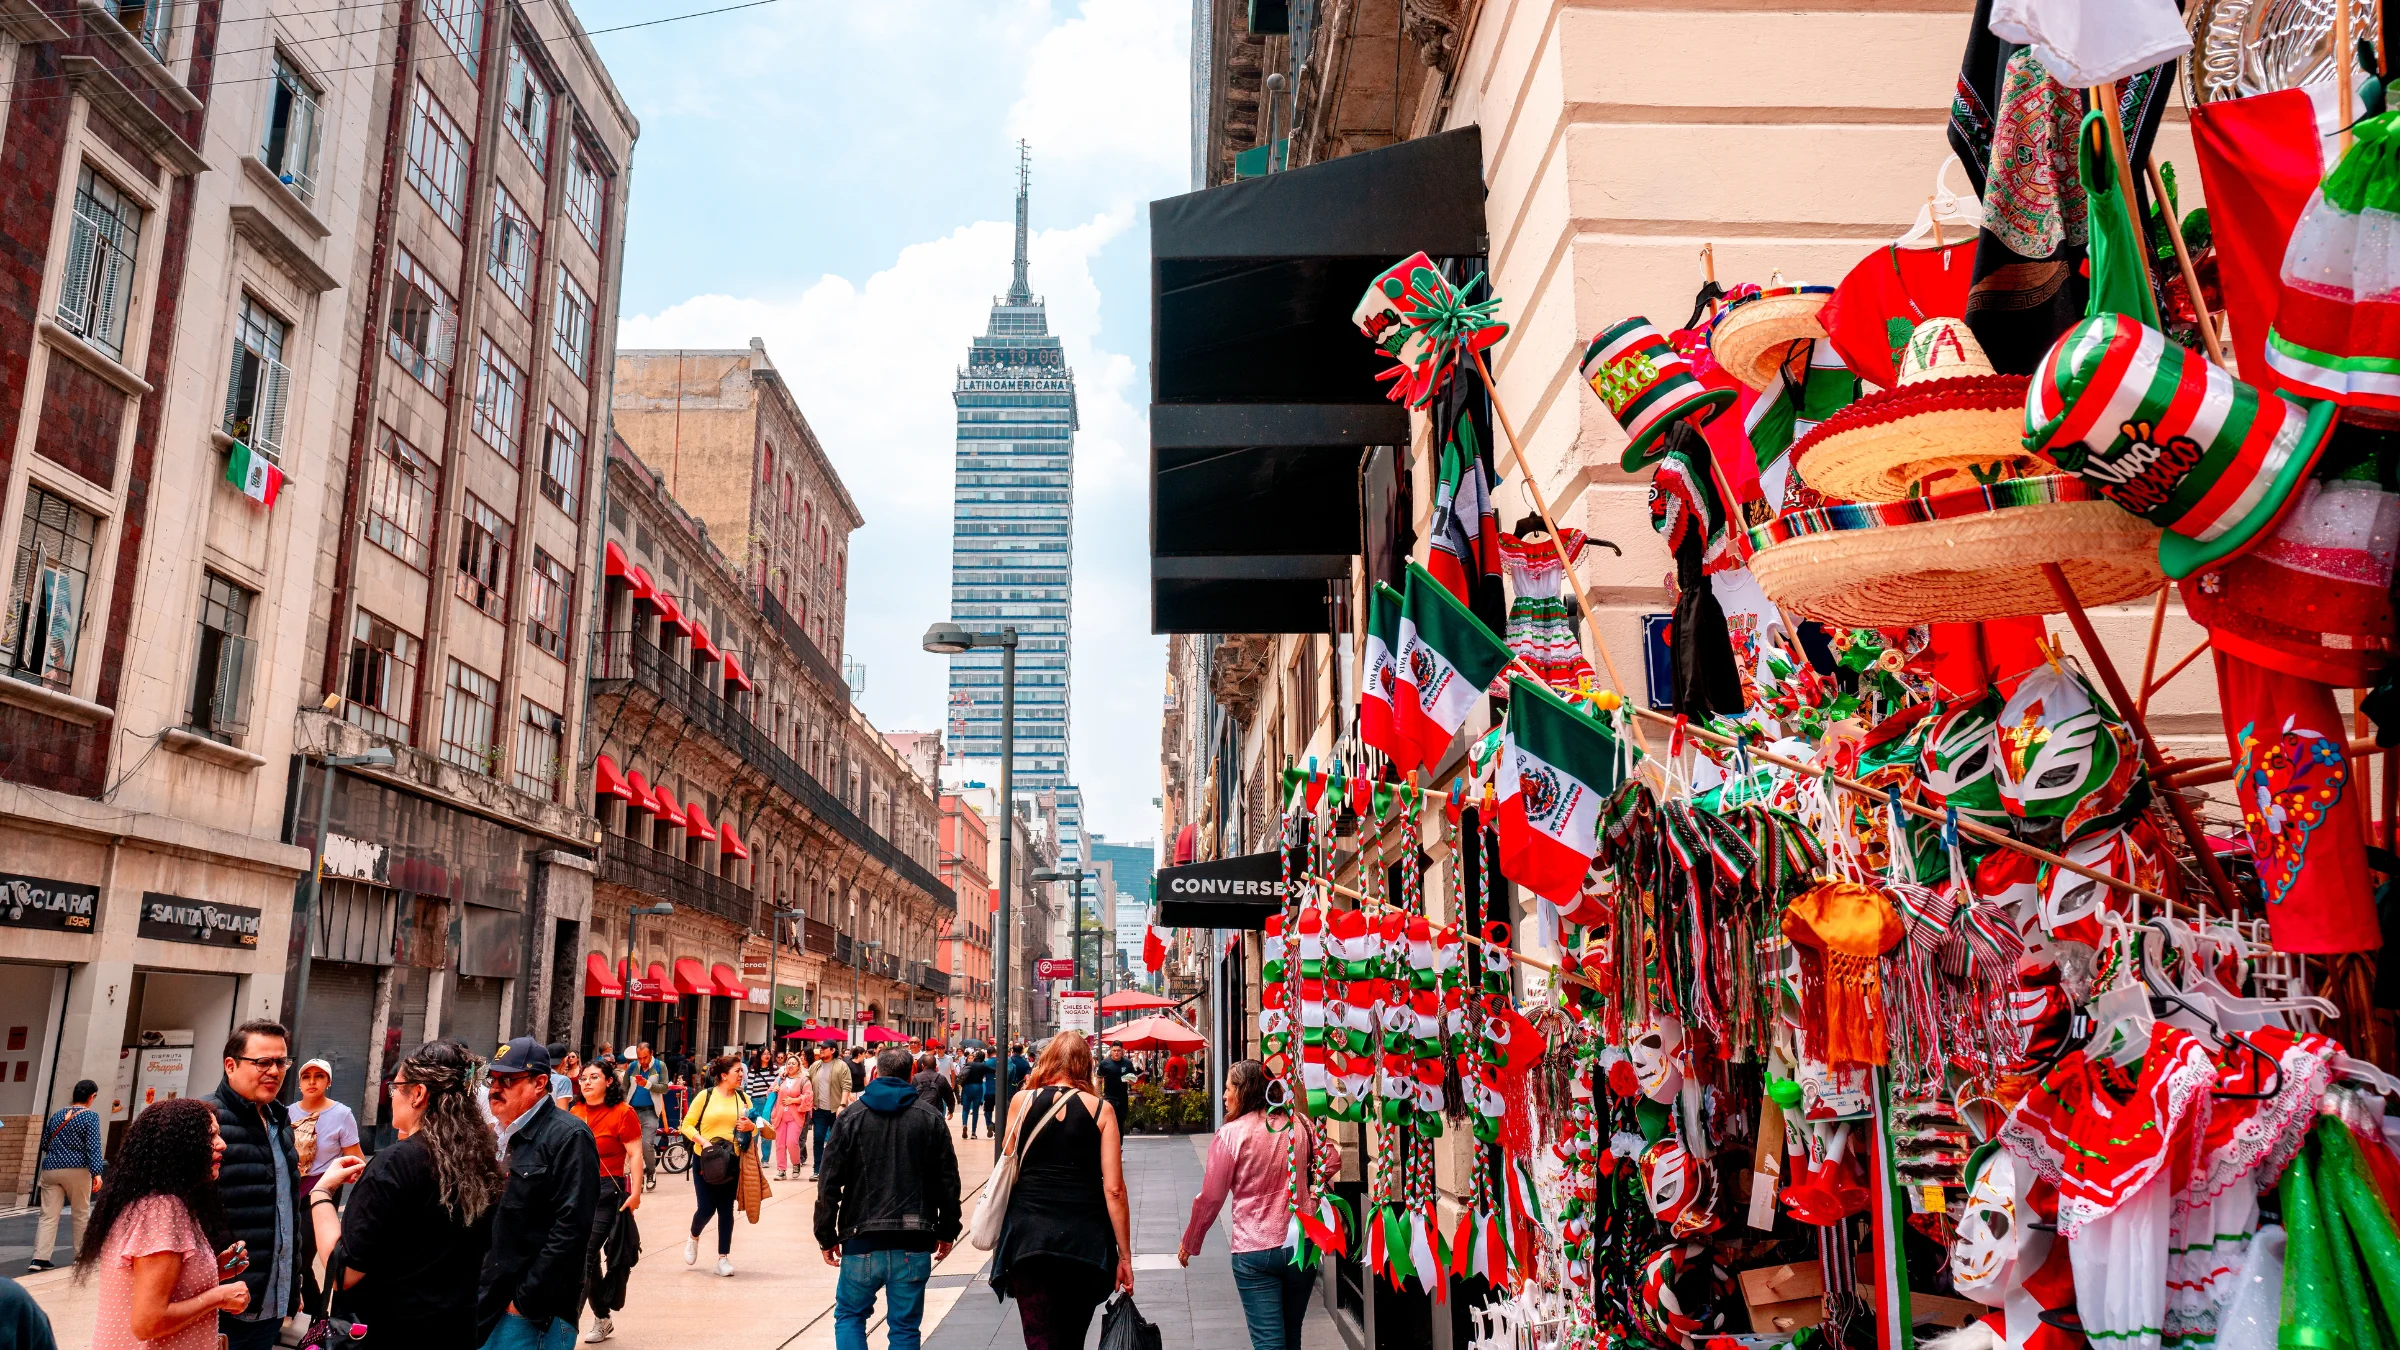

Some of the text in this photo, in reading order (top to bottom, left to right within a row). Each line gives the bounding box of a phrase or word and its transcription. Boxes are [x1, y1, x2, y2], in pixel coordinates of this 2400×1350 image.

[977, 349, 1059, 365] 13:19:06
[963, 380, 1064, 390] LATINOAMERICANA
[1601, 359, 1637, 393] VIVA
[1608, 367, 1656, 411] MEXICO
[2083, 441, 2161, 484] Viva
[1369, 648, 1388, 690] VIVA MEXIC
[1398, 656, 1408, 674] VIVA
[1549, 783, 1583, 837] MEXICO
[1171, 877, 1283, 896] CONVERSE
[29, 888, 94, 915] CLARA
[68, 916, 90, 928] 1924
[150, 903, 260, 934] SANTA CLARA
[146, 1061, 184, 1075] Frappés
